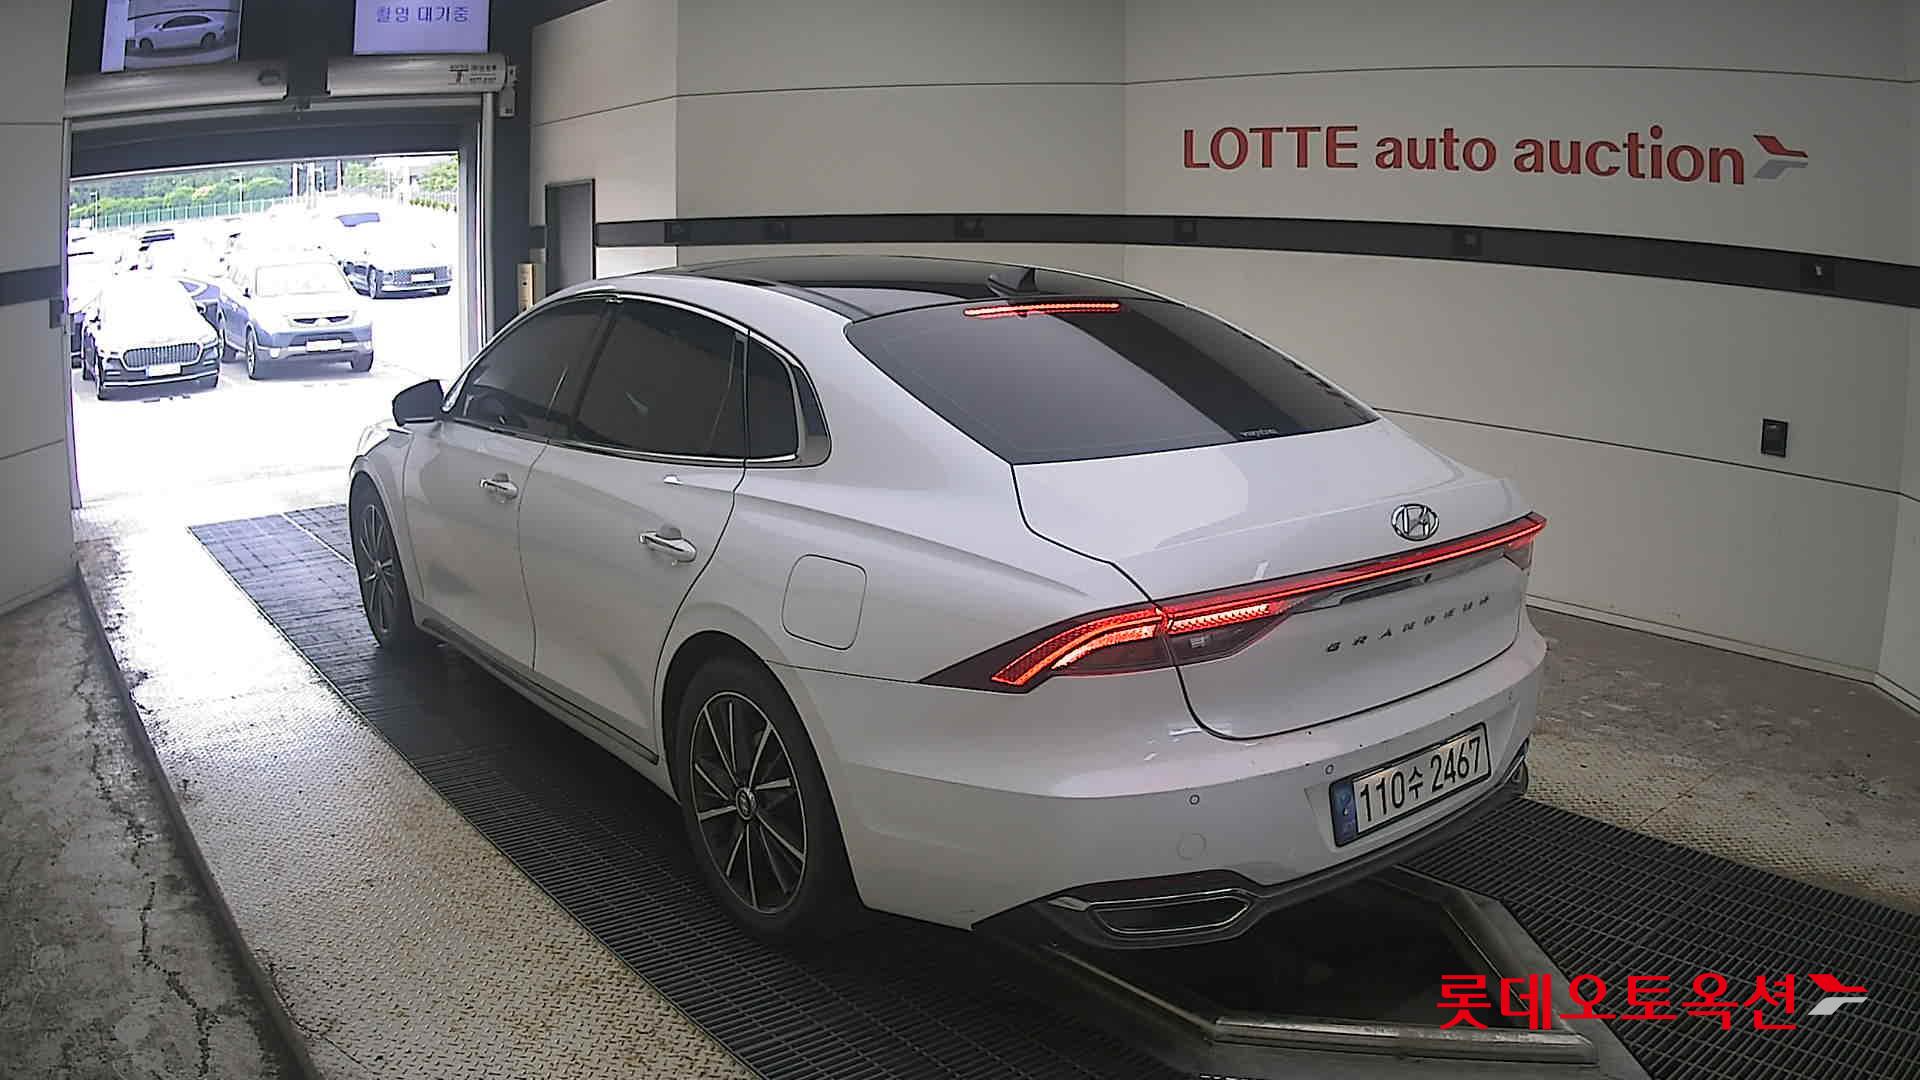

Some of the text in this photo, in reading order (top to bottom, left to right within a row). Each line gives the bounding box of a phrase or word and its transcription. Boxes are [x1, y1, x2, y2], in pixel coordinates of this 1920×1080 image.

[418, 6, 469, 23] 대기중
[1183, 124, 1745, 185] LOTTE auto auction
[1359, 736, 1481, 823] 110수 2467
